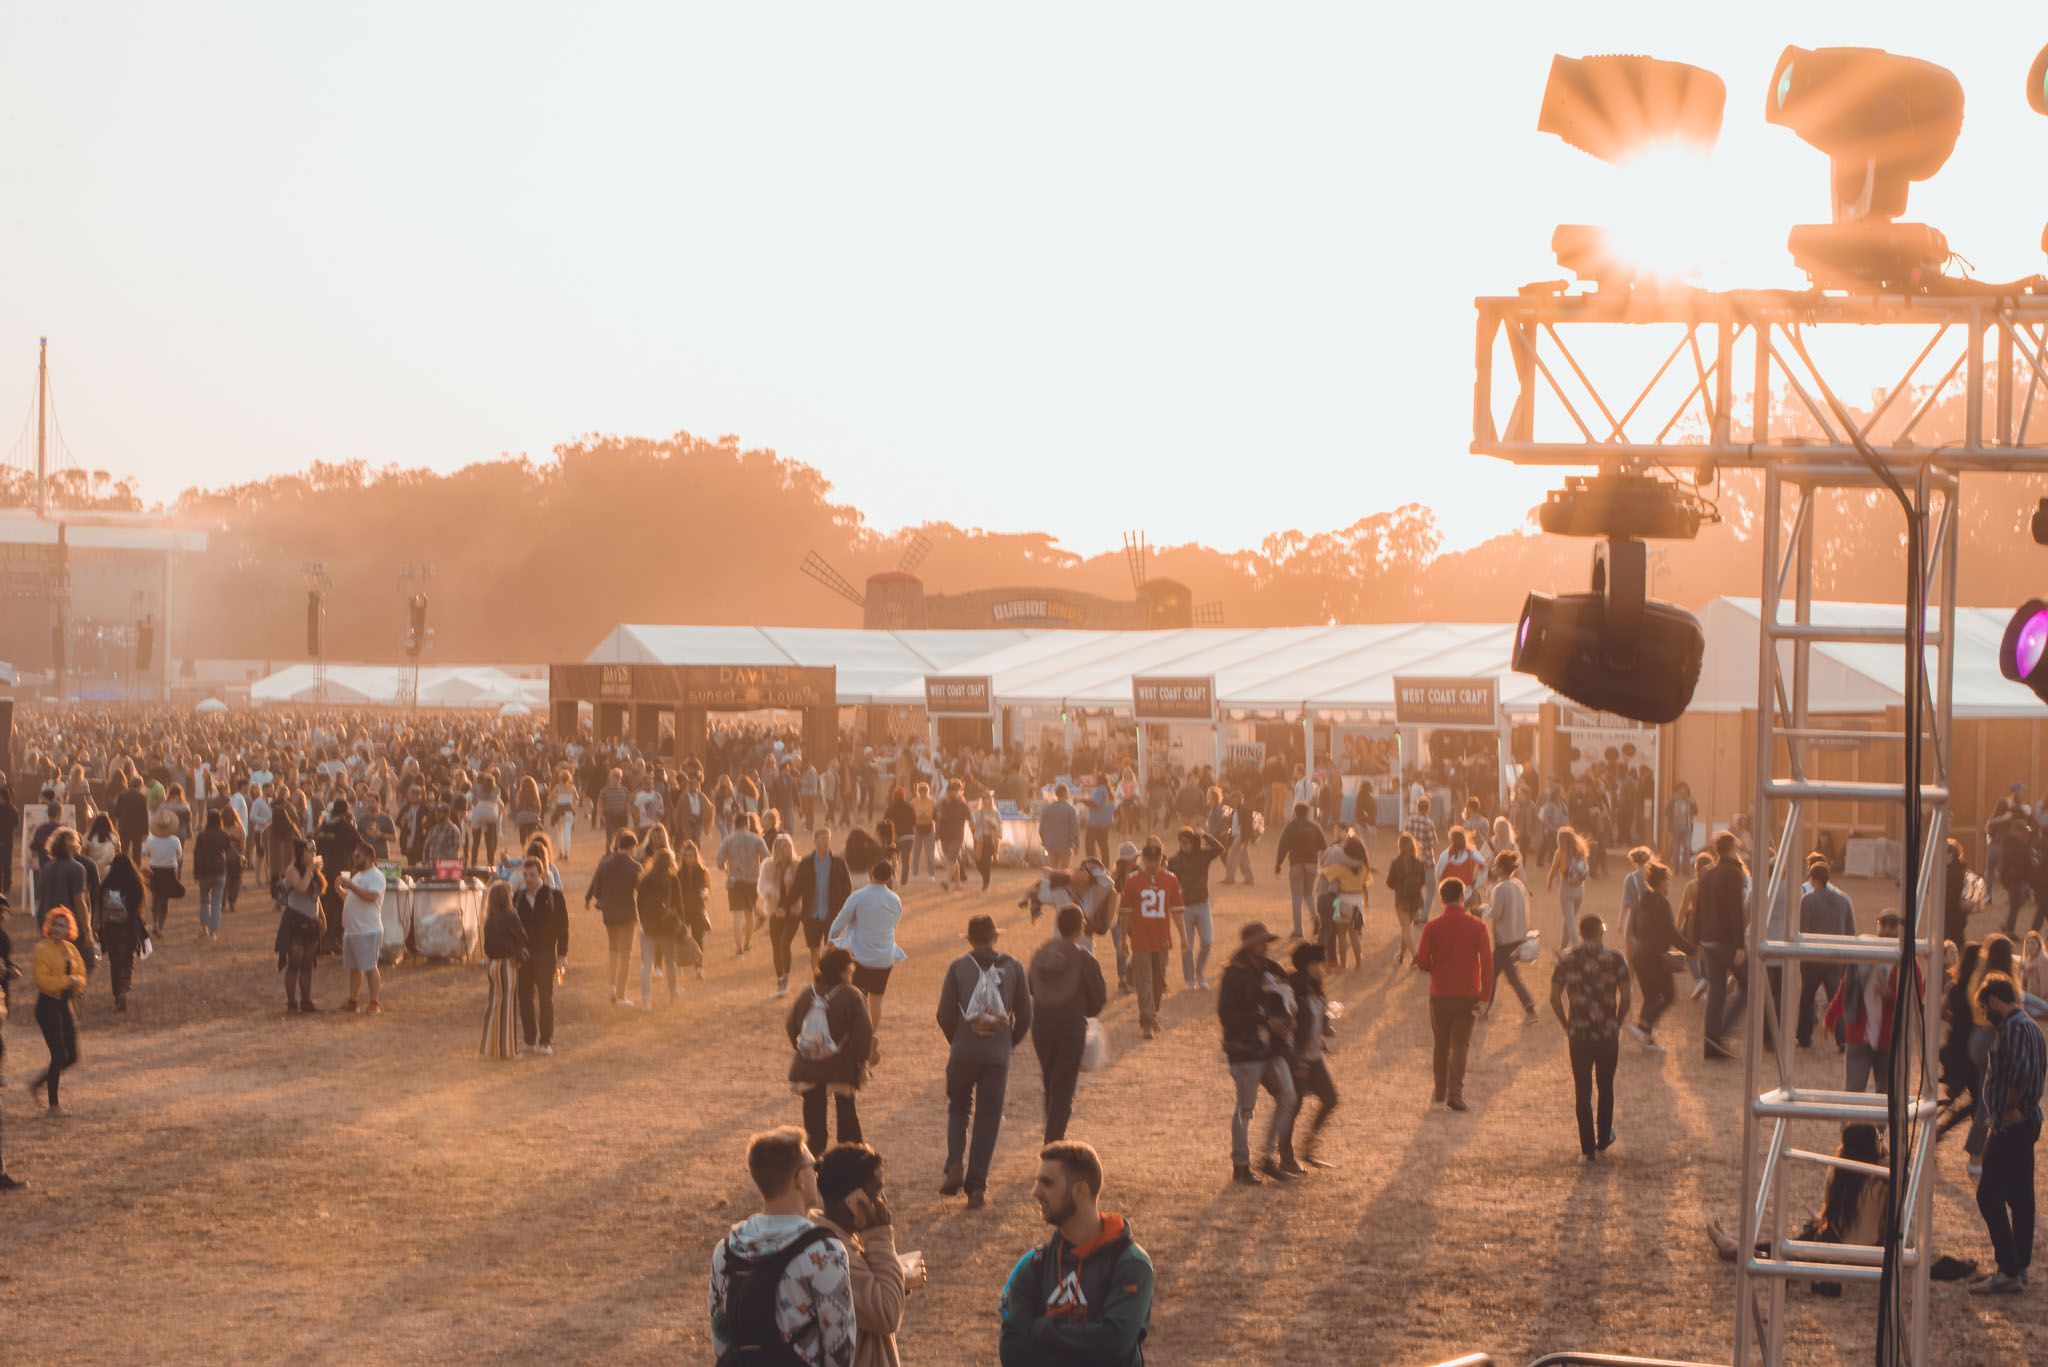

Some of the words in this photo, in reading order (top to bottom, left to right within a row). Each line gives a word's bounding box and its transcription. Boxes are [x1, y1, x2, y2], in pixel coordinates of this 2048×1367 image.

[930, 684, 945, 697] WEST
[947, 684, 966, 697] COAST
[967, 684, 985, 697] CRAFT
[1138, 687, 1158, 701] WEST
[1159, 687, 1181, 701] COAST
[1184, 687, 1206, 702] CRAFT
[1401, 688, 1425, 704] WEST
[1427, 688, 1456, 704] COAST
[1459, 688, 1488, 704] CRAFT
[1140, 889, 1166, 919] 21
